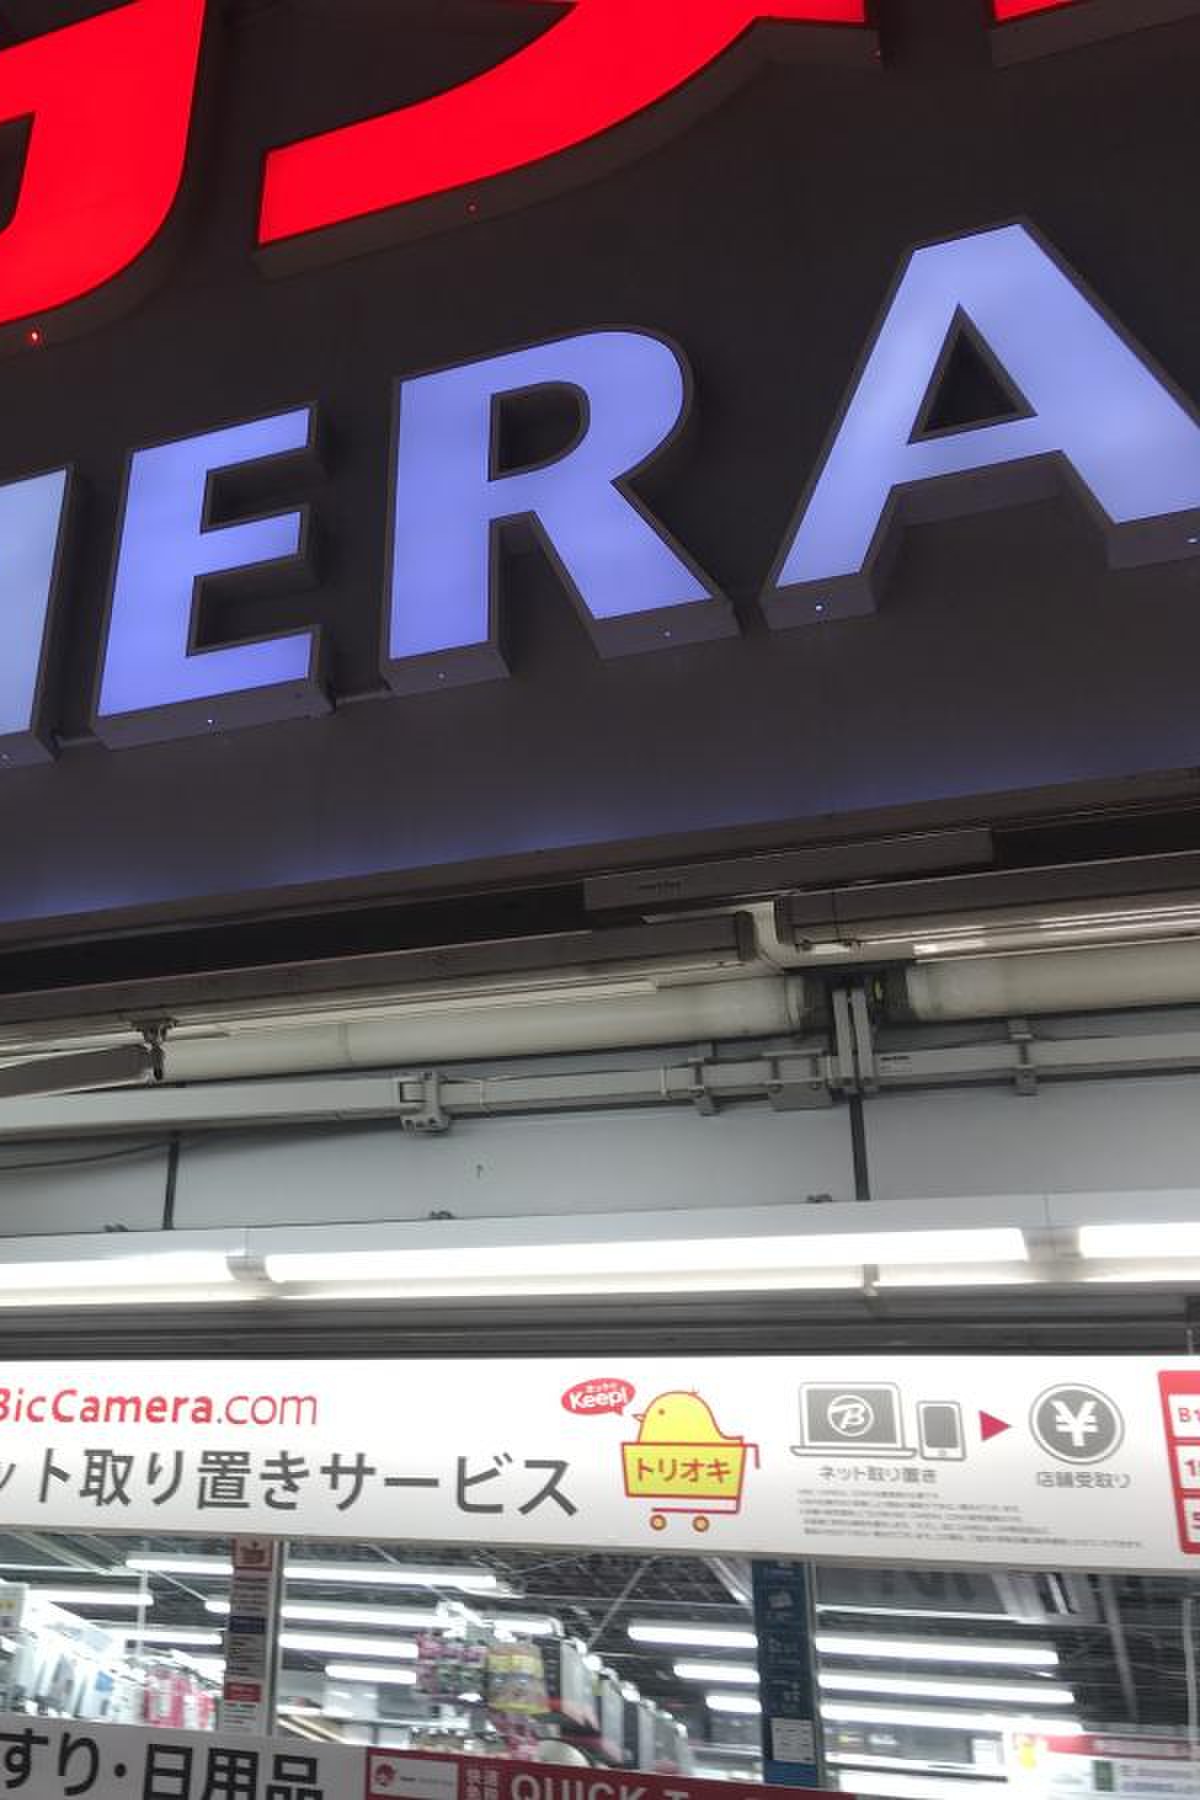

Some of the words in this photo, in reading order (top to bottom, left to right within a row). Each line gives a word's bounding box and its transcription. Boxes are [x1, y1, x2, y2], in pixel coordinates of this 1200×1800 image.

[569, 1386, 629, 1410] Keep!
[636, 1458, 732, 1483] トリオキ
